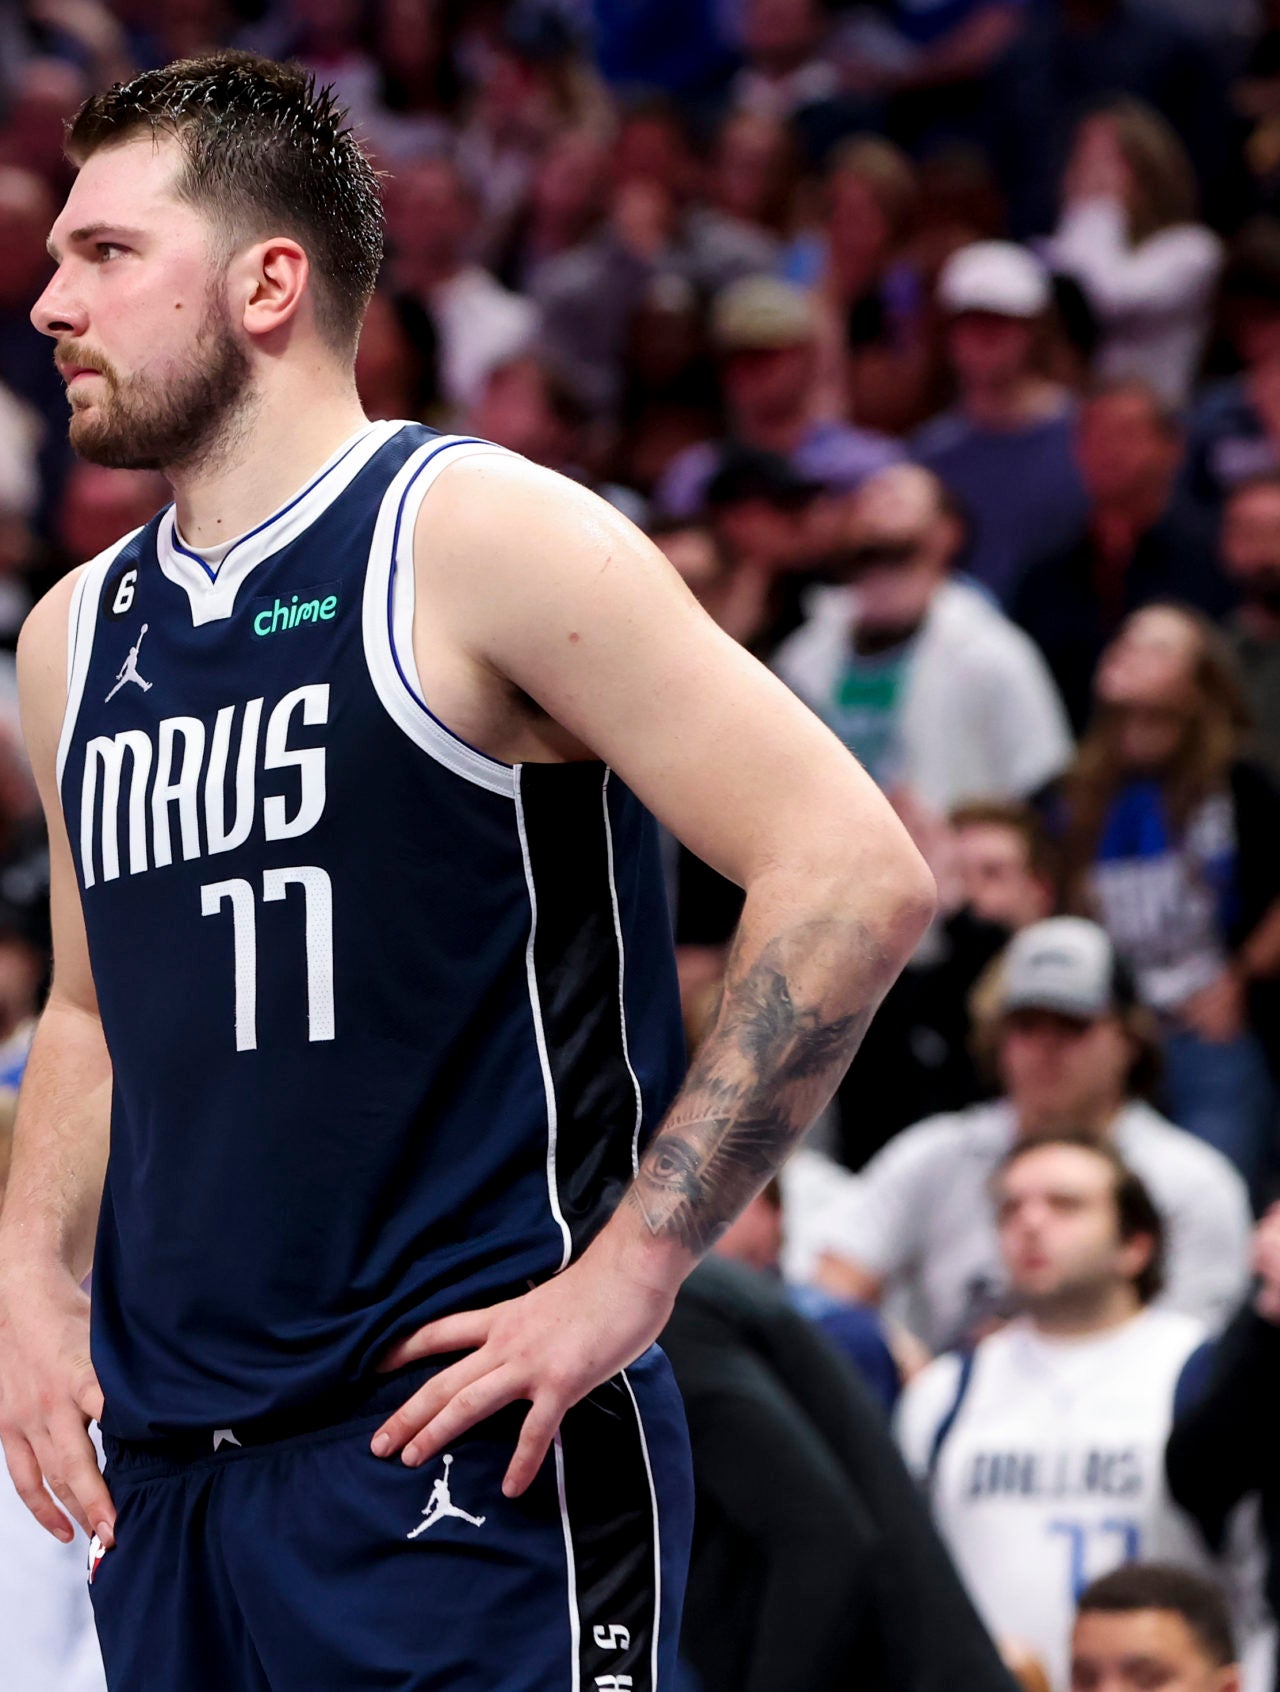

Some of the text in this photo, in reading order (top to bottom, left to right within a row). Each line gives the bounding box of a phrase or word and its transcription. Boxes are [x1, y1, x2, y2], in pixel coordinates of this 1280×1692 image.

[112, 569, 138, 615] 6
[253, 595, 338, 637] chime
[80, 682, 331, 890] MAVS
[200, 865, 336, 1053] 77
